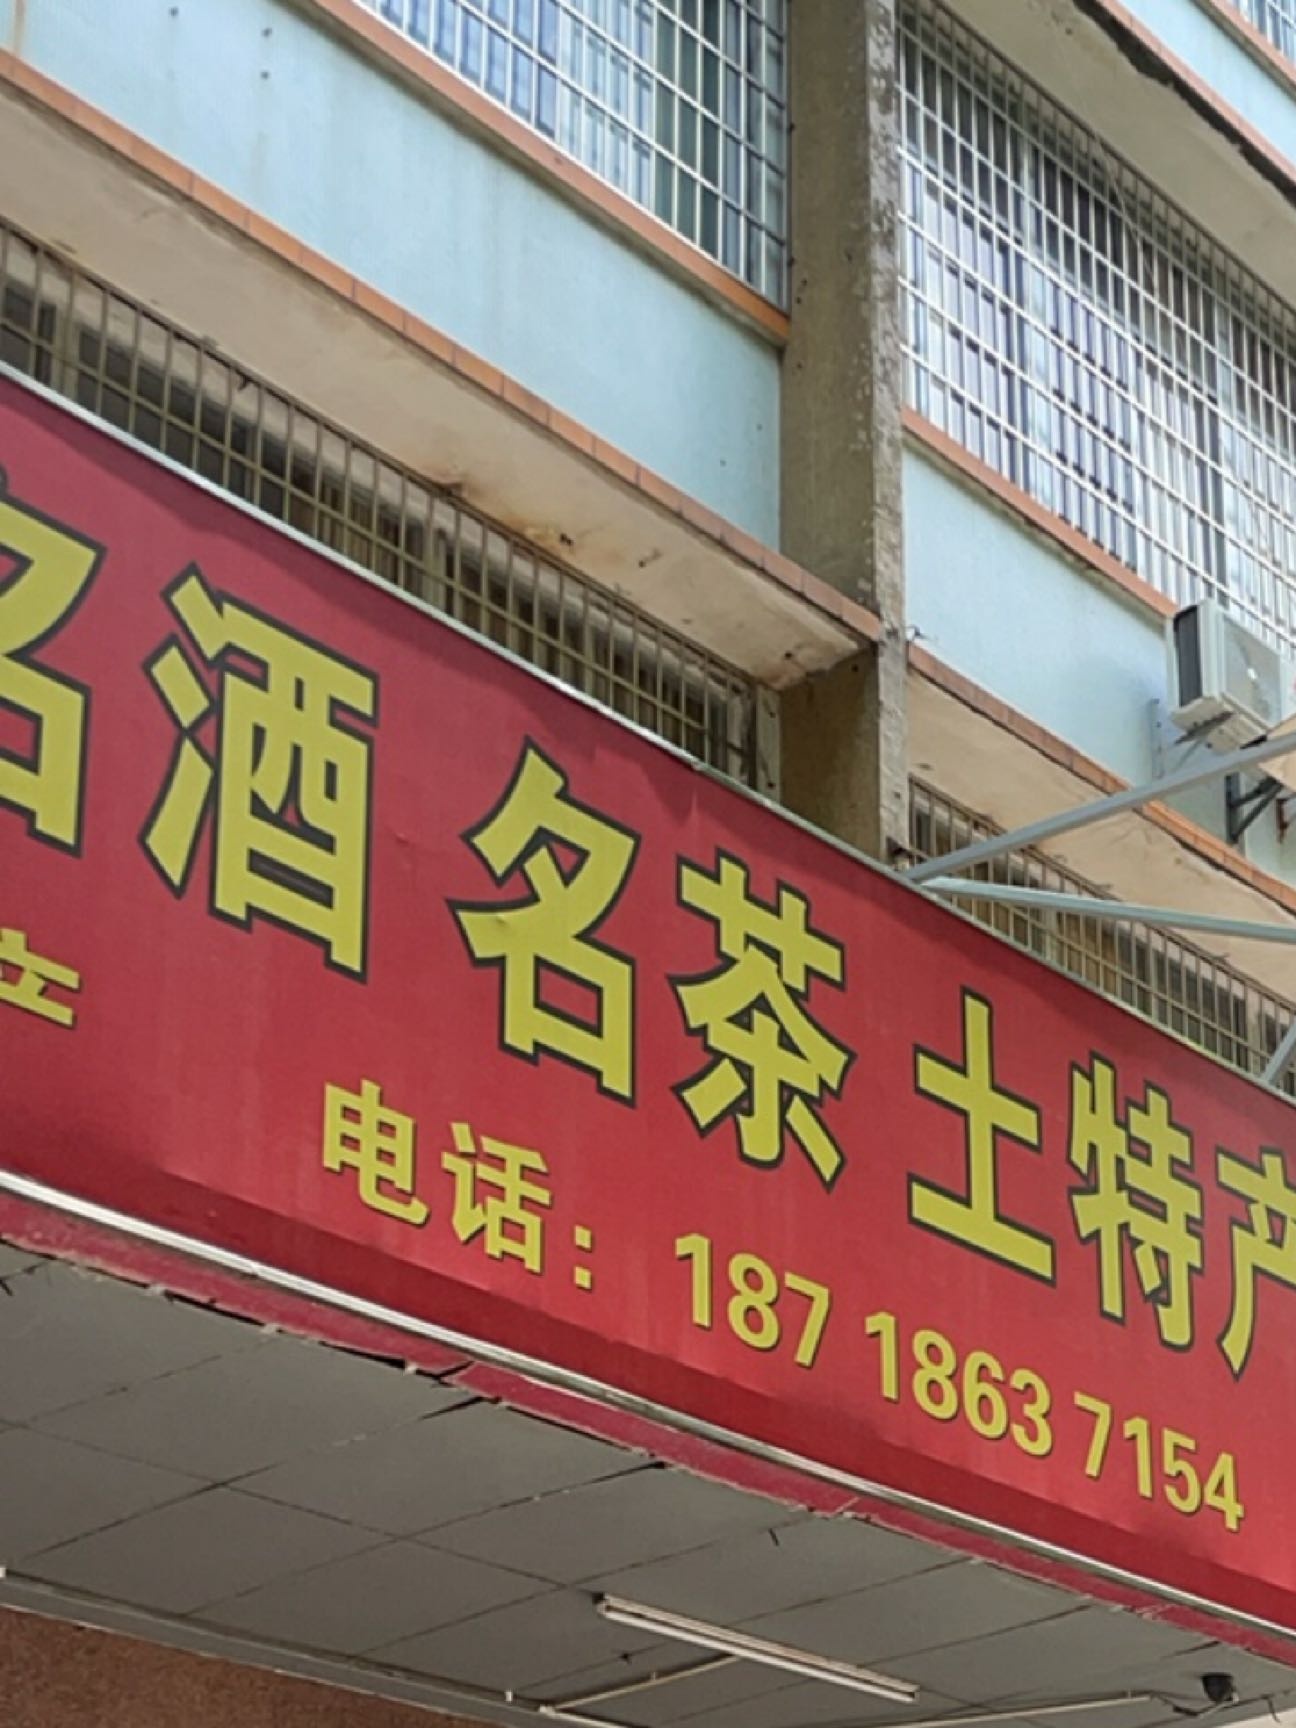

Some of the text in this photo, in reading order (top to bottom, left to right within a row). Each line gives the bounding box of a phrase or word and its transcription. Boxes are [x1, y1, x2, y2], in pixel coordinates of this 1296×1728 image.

[674, 1232, 832, 1368] 187
[865, 1311, 1053, 1458] 1863
[1074, 1390, 1244, 1531] 7154
